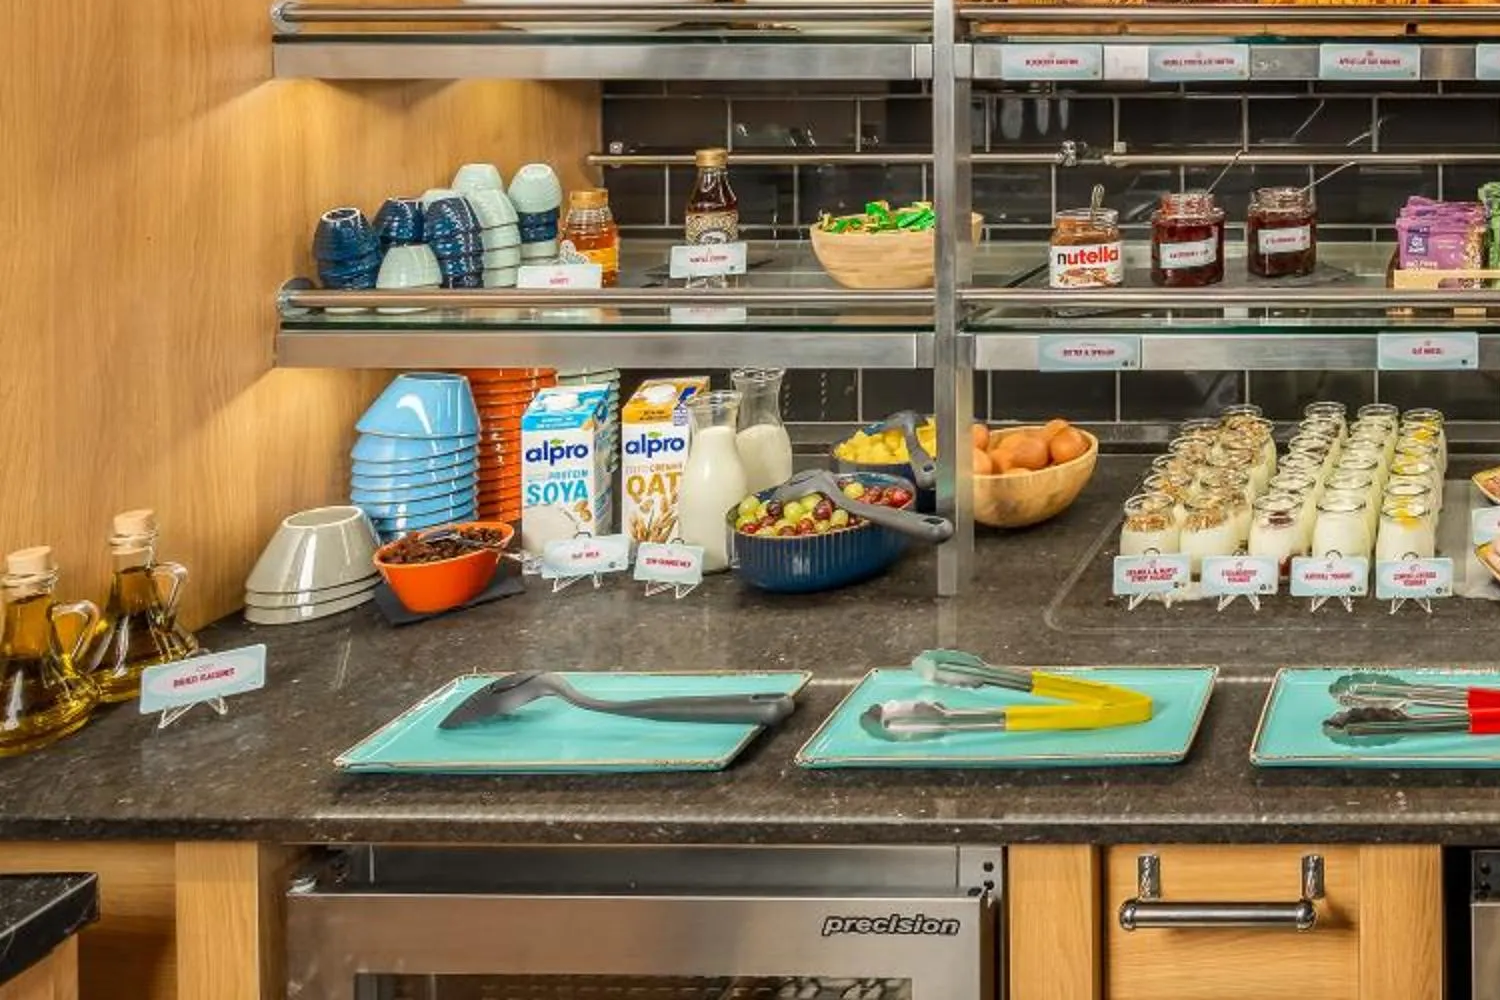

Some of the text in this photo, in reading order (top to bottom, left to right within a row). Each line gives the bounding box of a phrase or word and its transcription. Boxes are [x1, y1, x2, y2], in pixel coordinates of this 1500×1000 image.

[1056, 245, 1119, 266] nutella
[525, 439, 589, 466] alpro
[625, 433, 686, 459] alpro
[526, 479, 589, 506] SOYA
[626, 472, 684, 502] OAT
[822, 913, 960, 936] precision
